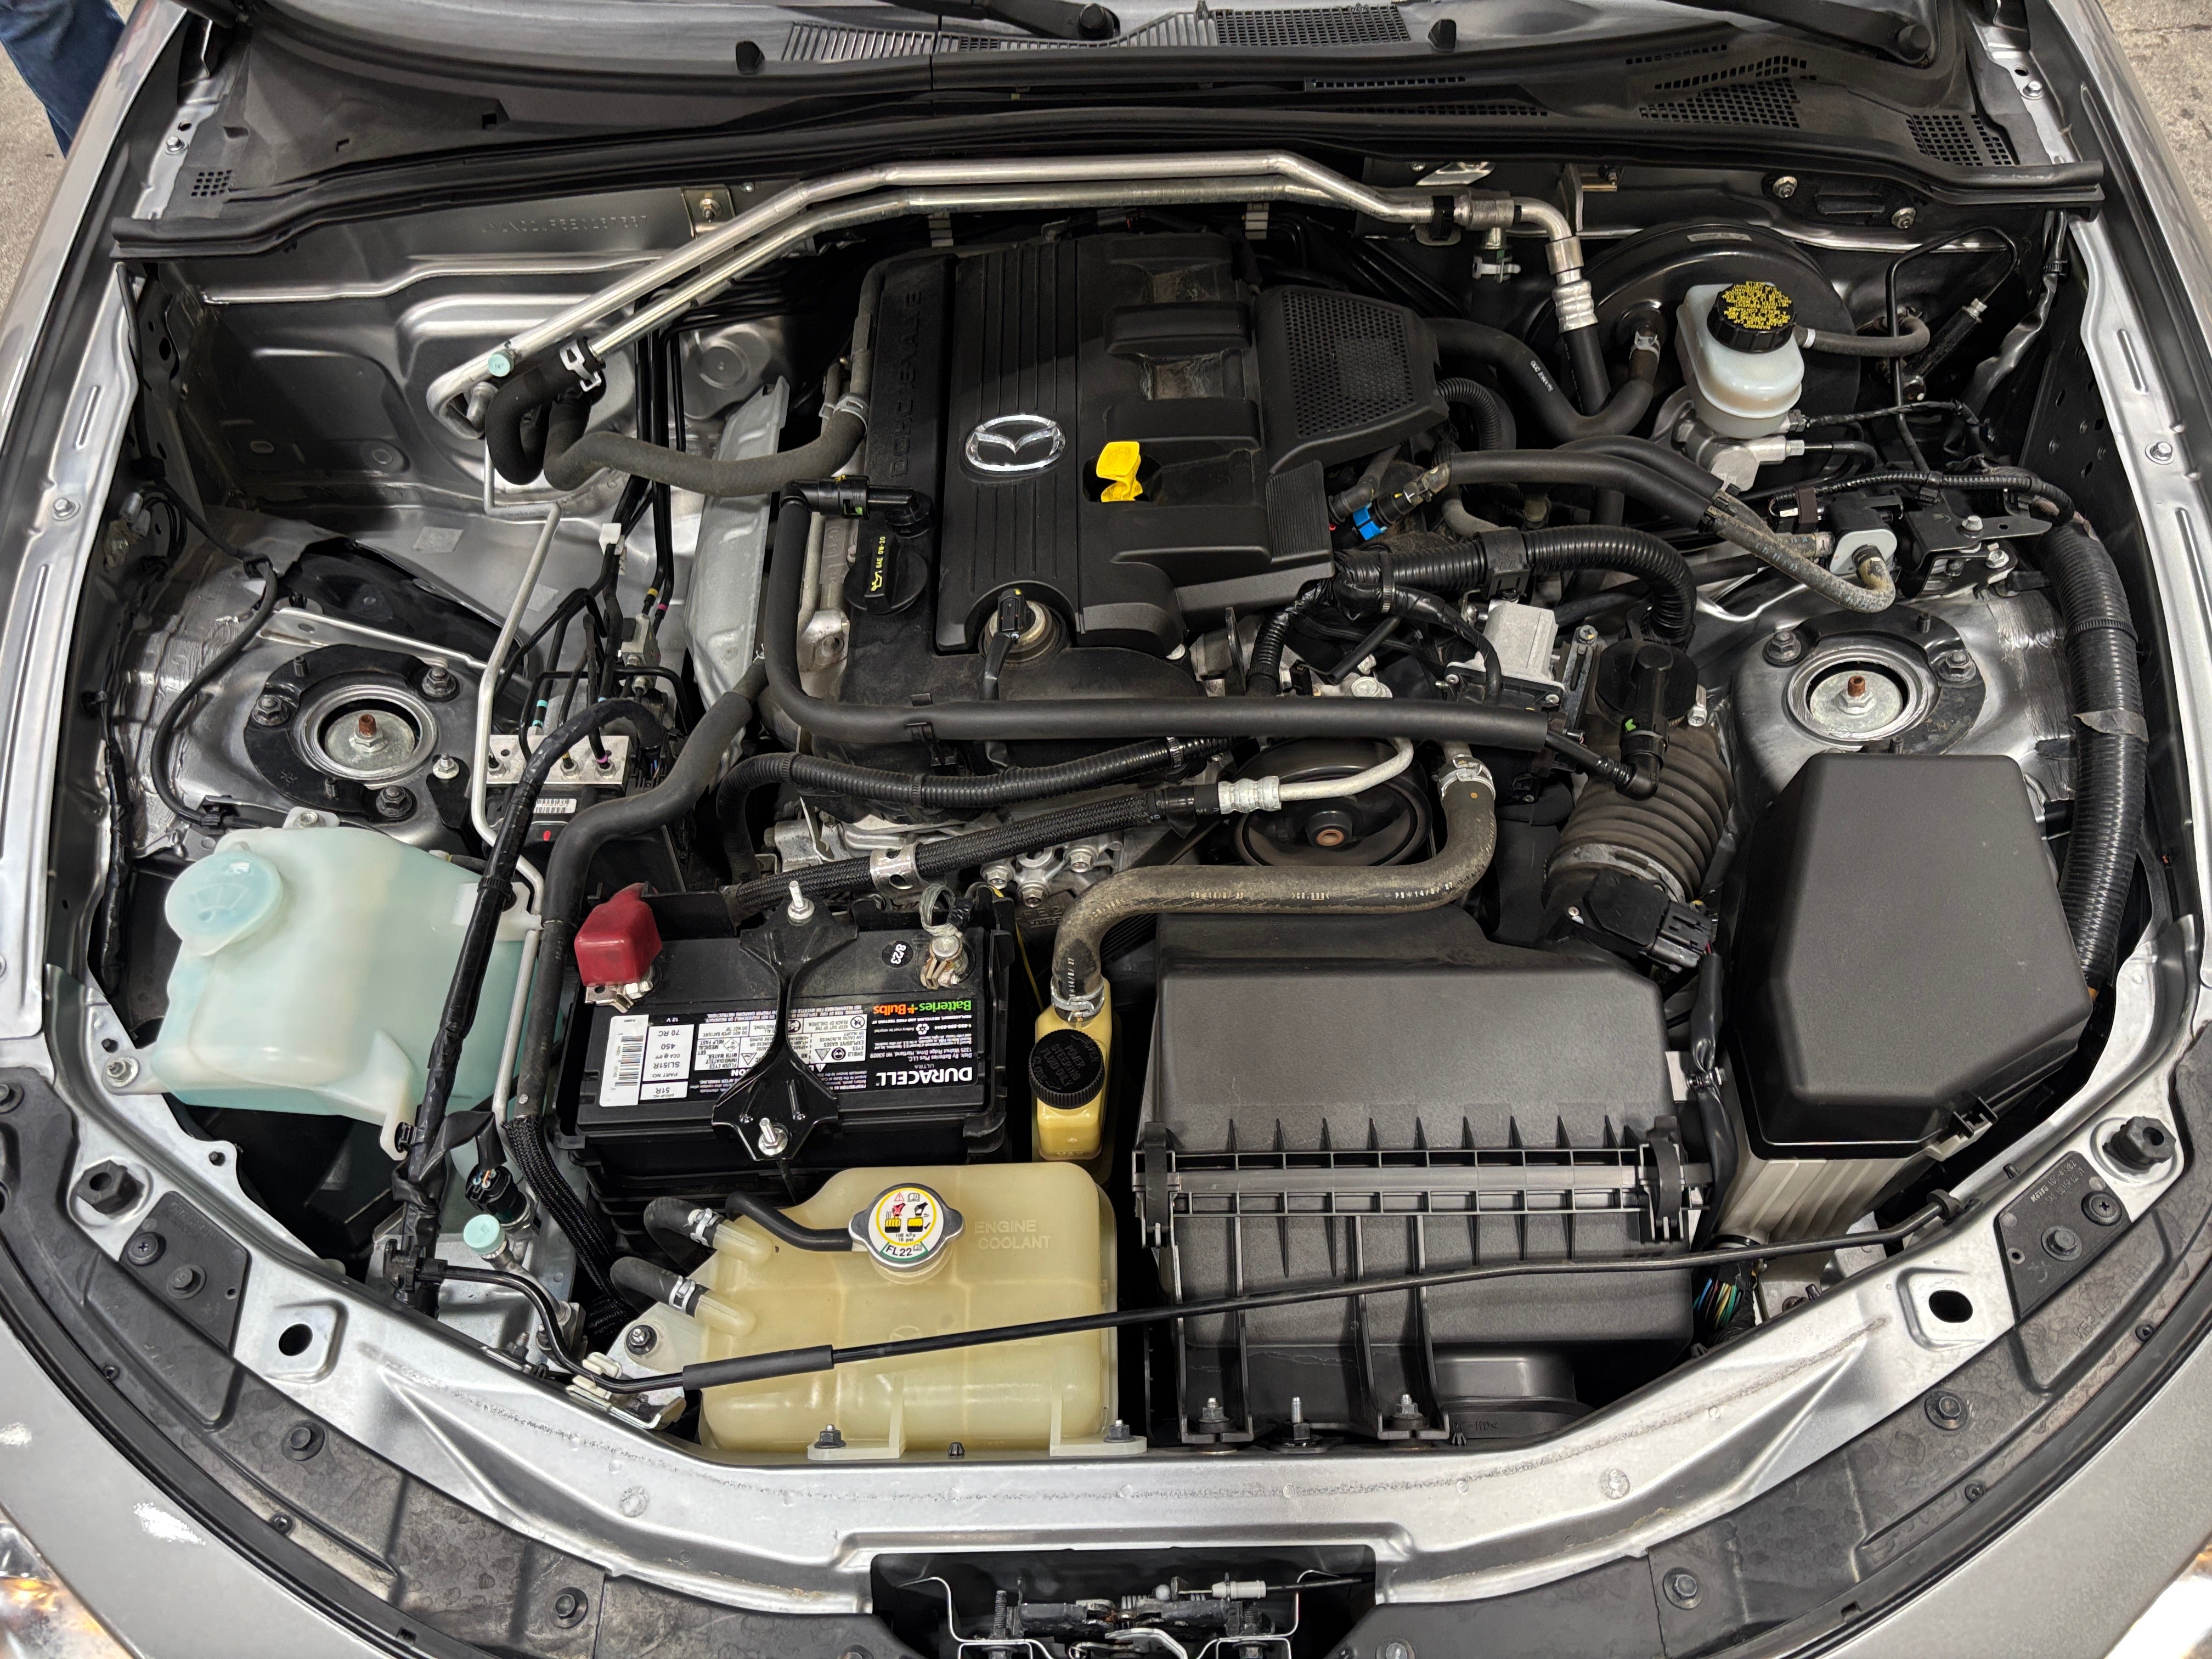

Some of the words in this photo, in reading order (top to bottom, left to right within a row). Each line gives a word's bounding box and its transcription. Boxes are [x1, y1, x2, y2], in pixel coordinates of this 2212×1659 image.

[877, 536, 886, 555] 0W-20
[890, 944, 907, 964] 8/23
[653, 1061, 680, 1069] SLI51R
[1041, 1047, 1060, 1070] FLUID
[1051, 1043, 1081, 1081] STEERING
[1064, 1045, 1086, 1069] POWER
[875, 1066, 973, 1086] DURACELL
[974, 1220, 1037, 1234] ENGINE
[885, 1245, 913, 1257] FL22
[978, 1235, 1051, 1250] COOLANT
